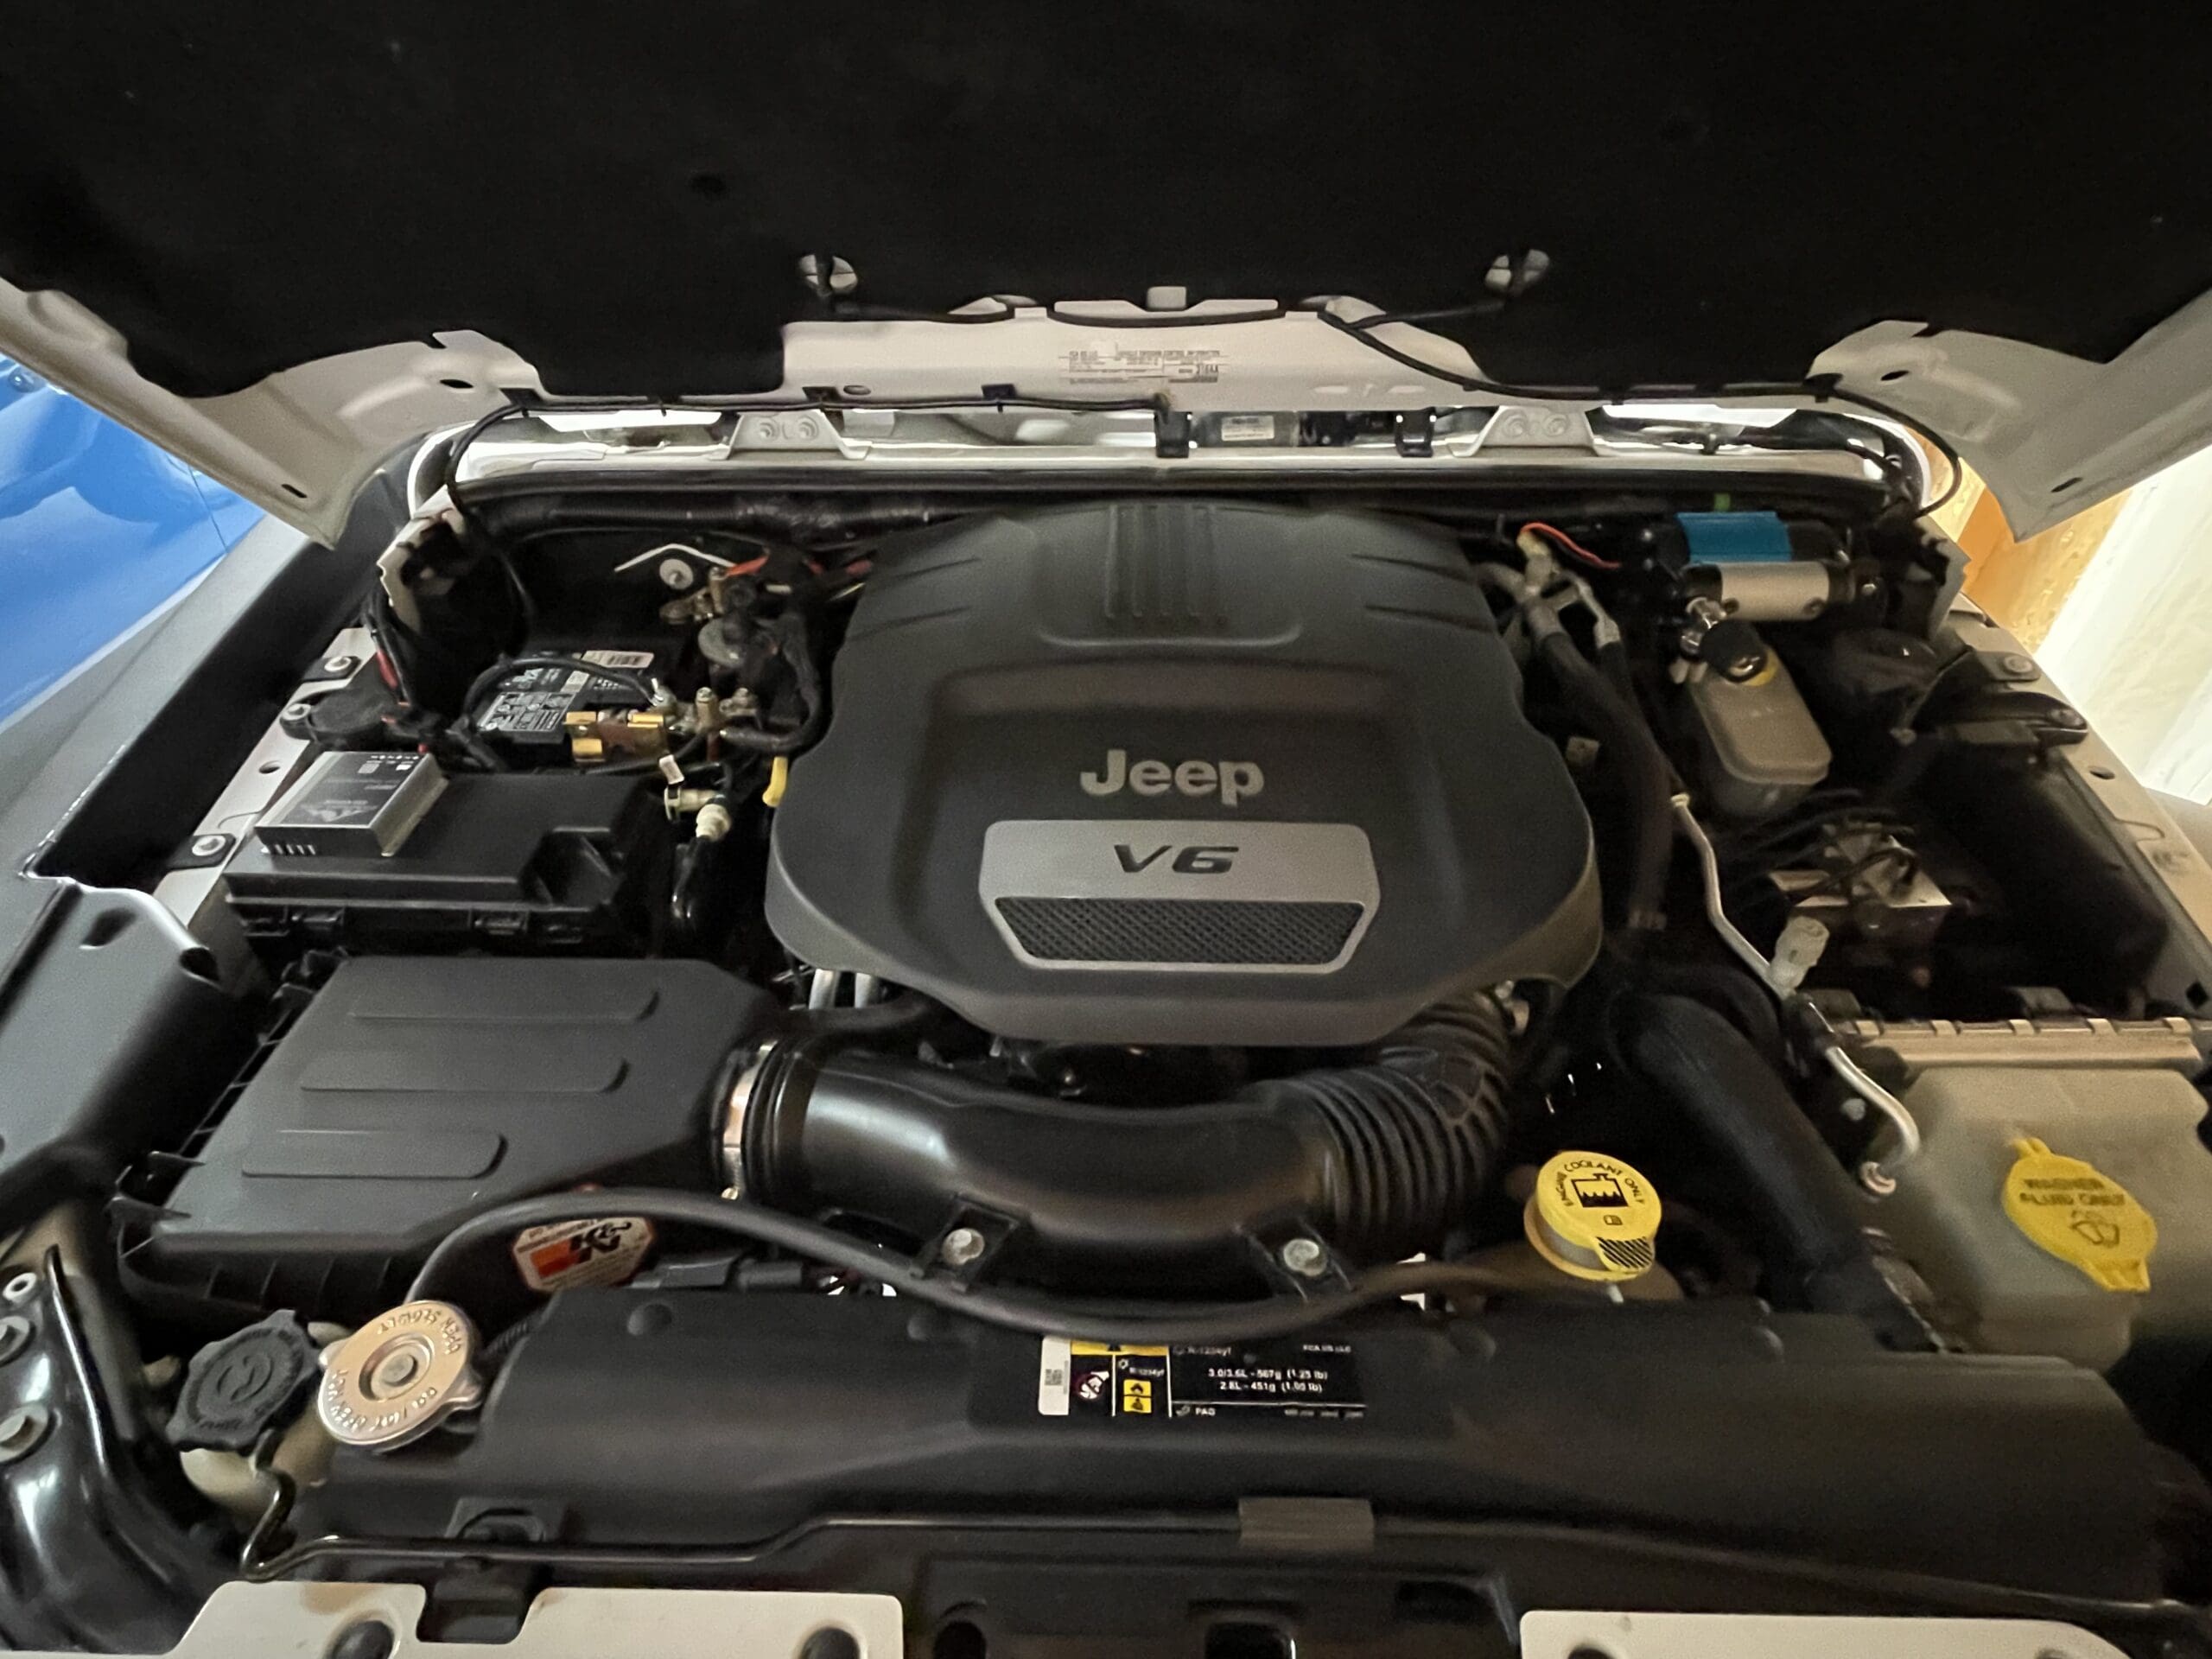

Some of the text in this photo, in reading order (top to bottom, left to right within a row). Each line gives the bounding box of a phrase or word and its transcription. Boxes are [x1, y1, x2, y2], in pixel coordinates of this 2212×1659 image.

[1079, 749, 1265, 807] Jeep
[1114, 844, 1239, 874] V6
[1564, 1160, 1623, 1176] COOLANT
[1624, 1177, 1644, 1204] ONLY
